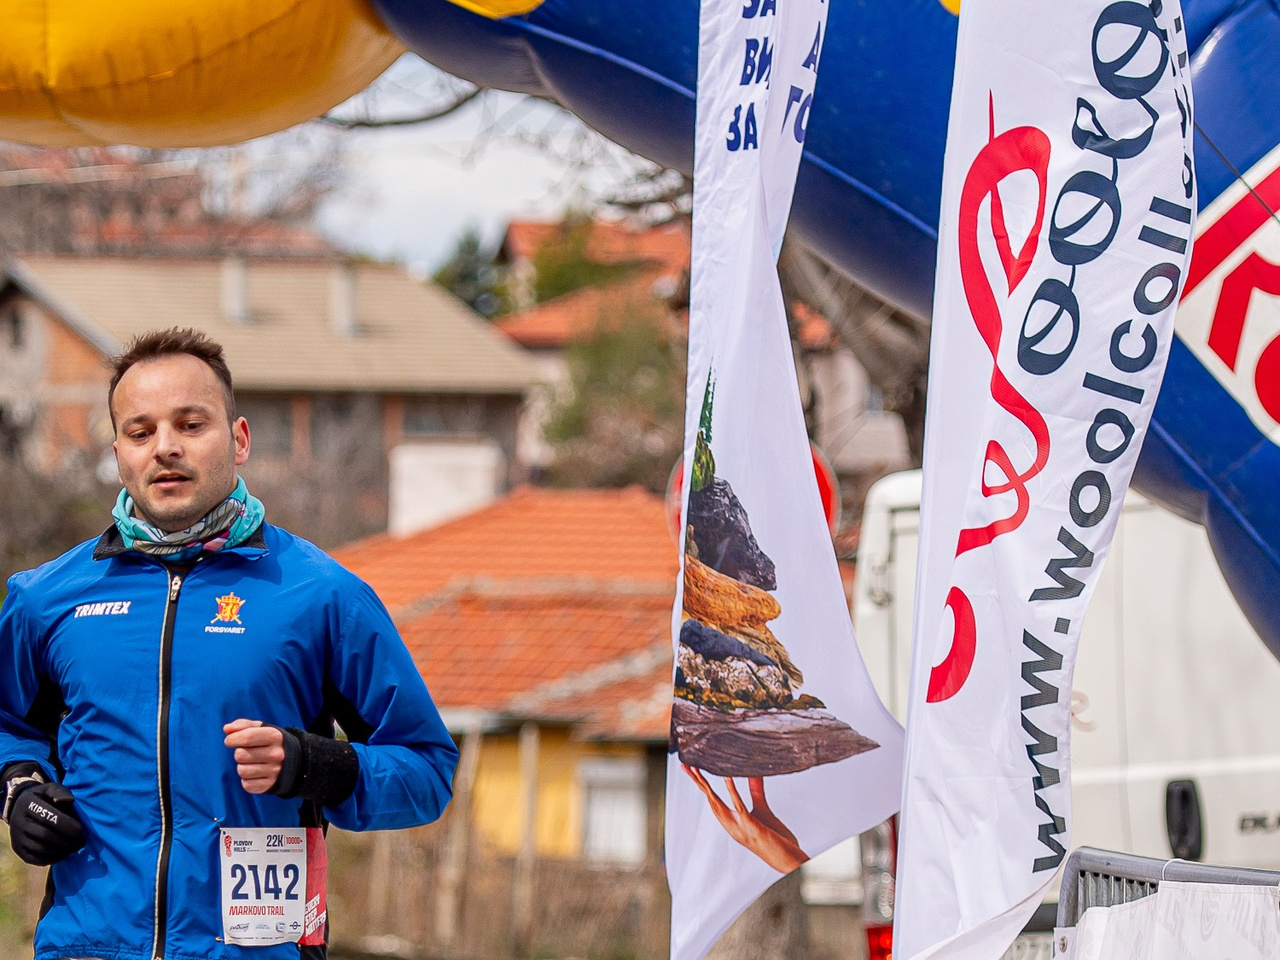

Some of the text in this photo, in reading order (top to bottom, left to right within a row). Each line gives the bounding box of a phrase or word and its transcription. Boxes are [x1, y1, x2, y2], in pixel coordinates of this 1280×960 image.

[73, 600, 132, 618] TRIMTEX
[204, 625, 246, 634] FORSVARET
[28, 801, 59, 824] KIPSTA
[266, 834, 284, 847] 22K
[230, 863, 299, 901] 2142
[228, 905, 285, 916] MARKOVO TRAIL
